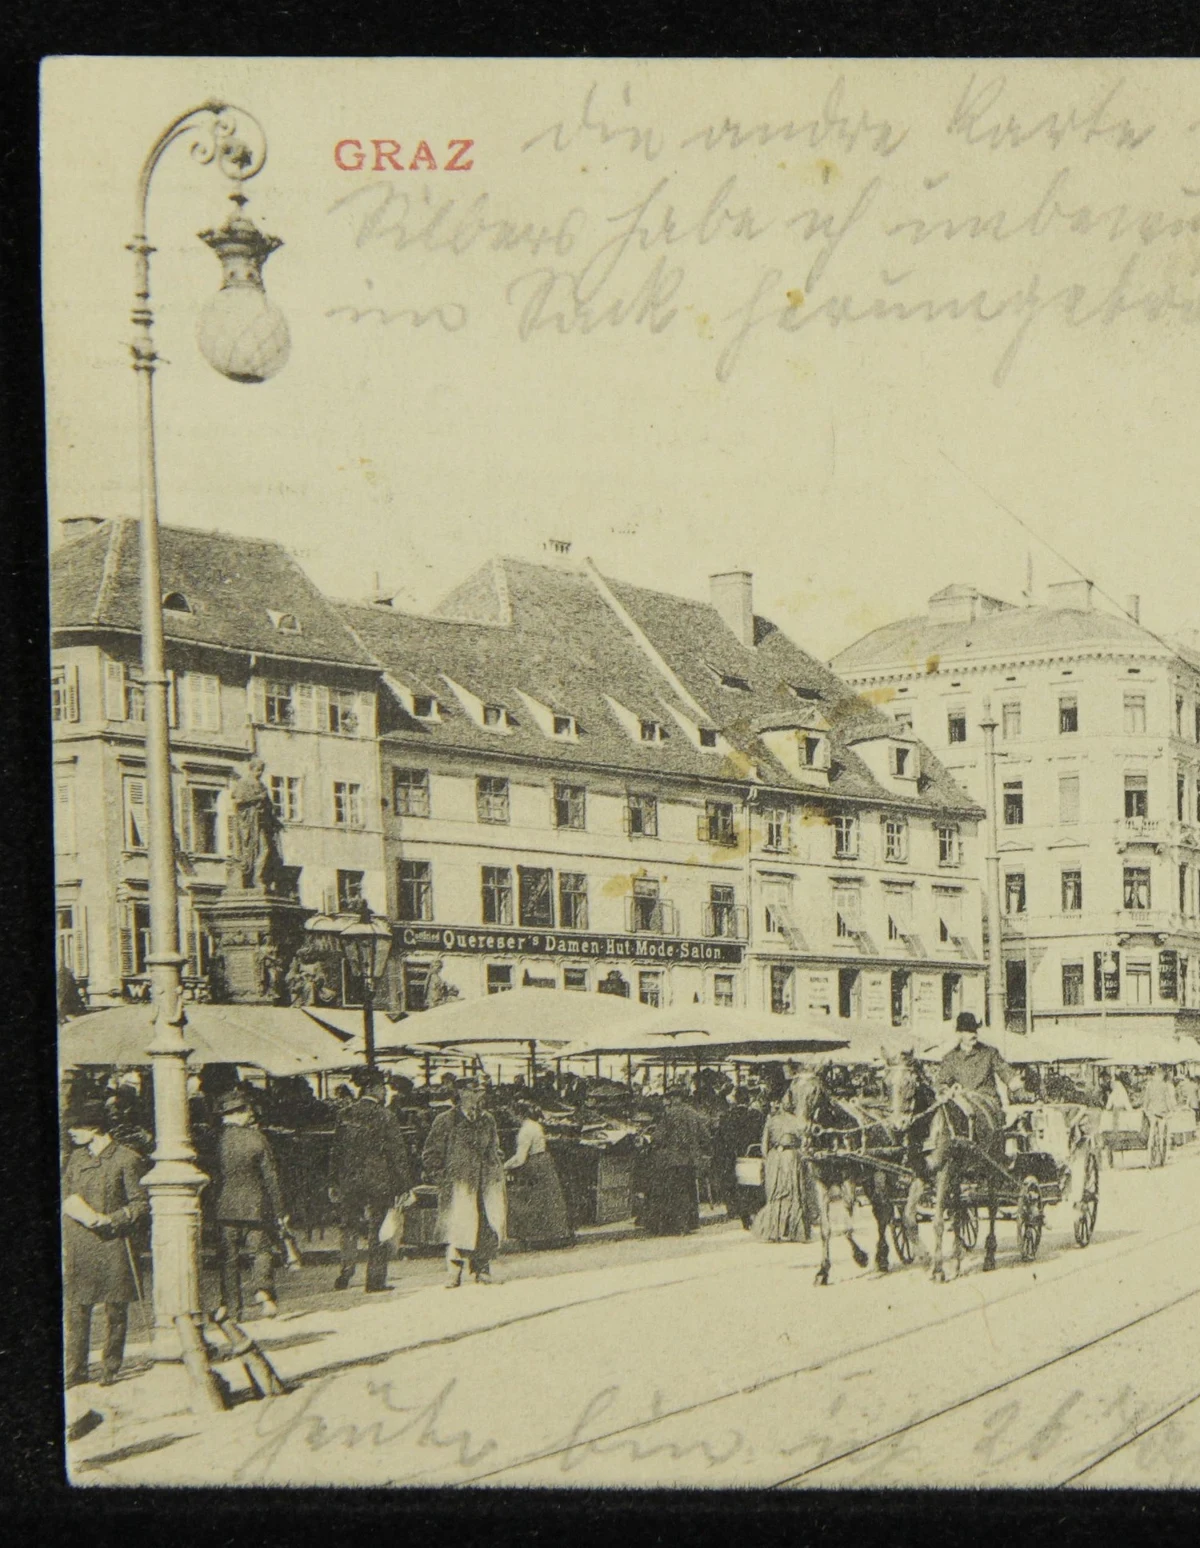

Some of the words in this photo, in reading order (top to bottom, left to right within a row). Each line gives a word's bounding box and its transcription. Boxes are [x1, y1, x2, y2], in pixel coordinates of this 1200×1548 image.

[521, 80, 666, 162] die
[785, 174, 882, 294] ich
[545, 935, 600, 955] Damen
[605, 938, 631, 956] Hut
[635, 940, 674, 958] Mode
